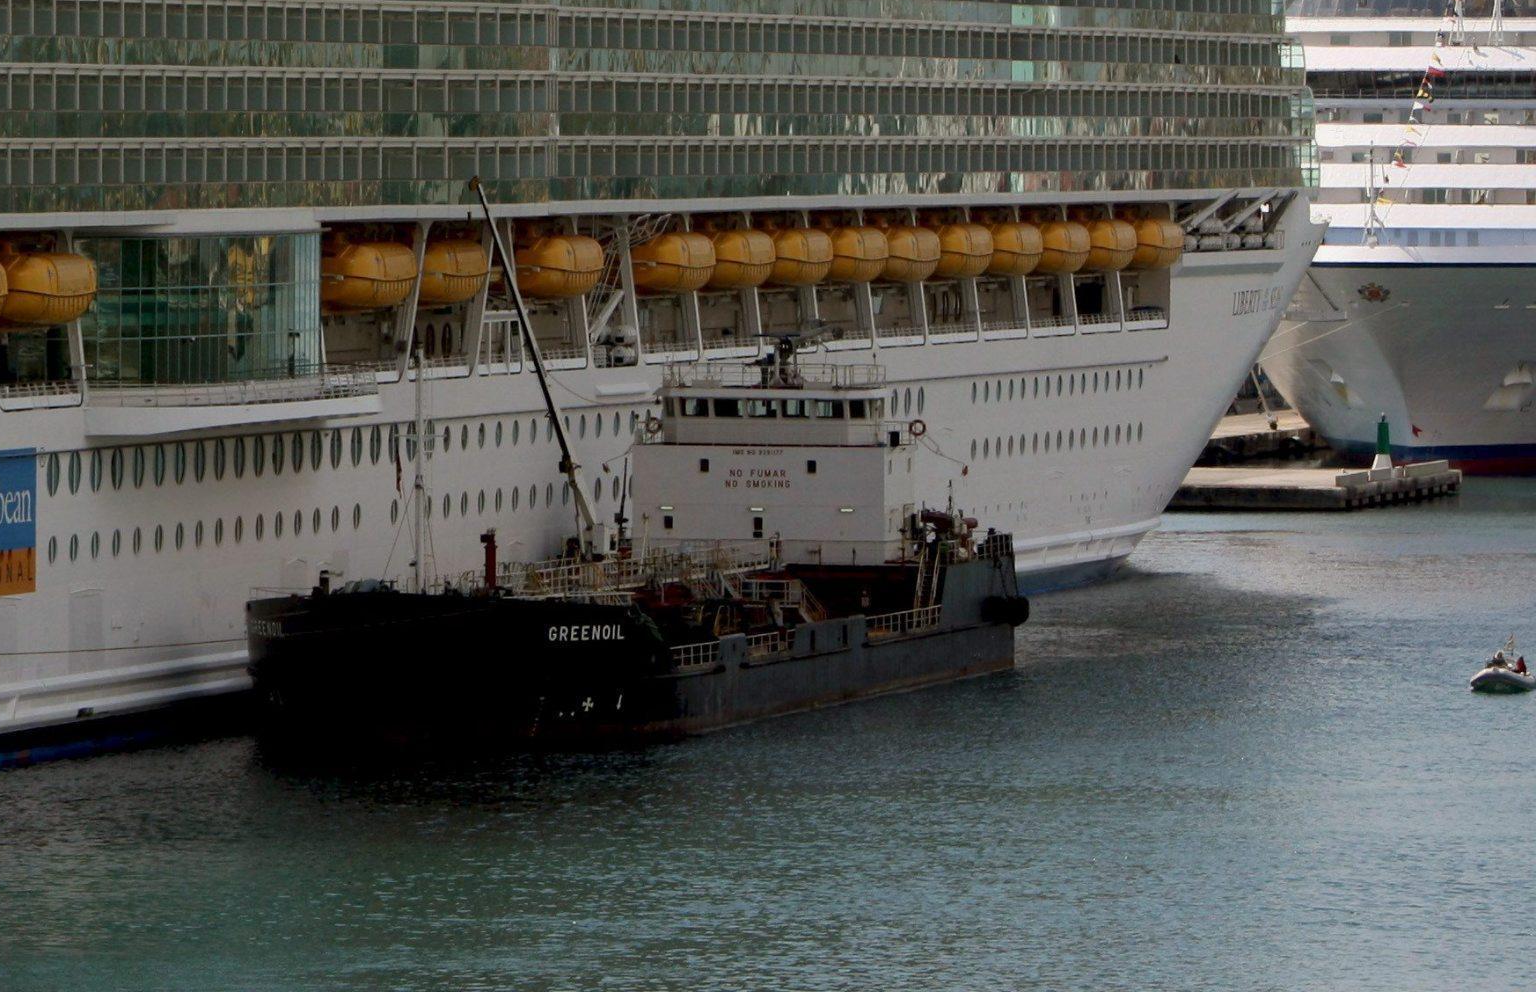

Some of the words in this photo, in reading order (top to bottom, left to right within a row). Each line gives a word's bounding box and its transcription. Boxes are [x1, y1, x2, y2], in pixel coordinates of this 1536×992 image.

[729, 469, 743, 478] NO
[750, 469, 786, 478] FUMAR
[725, 480, 738, 488] NO
[745, 480, 791, 488] SMOKING
[548, 624, 625, 641] GREENOIL
